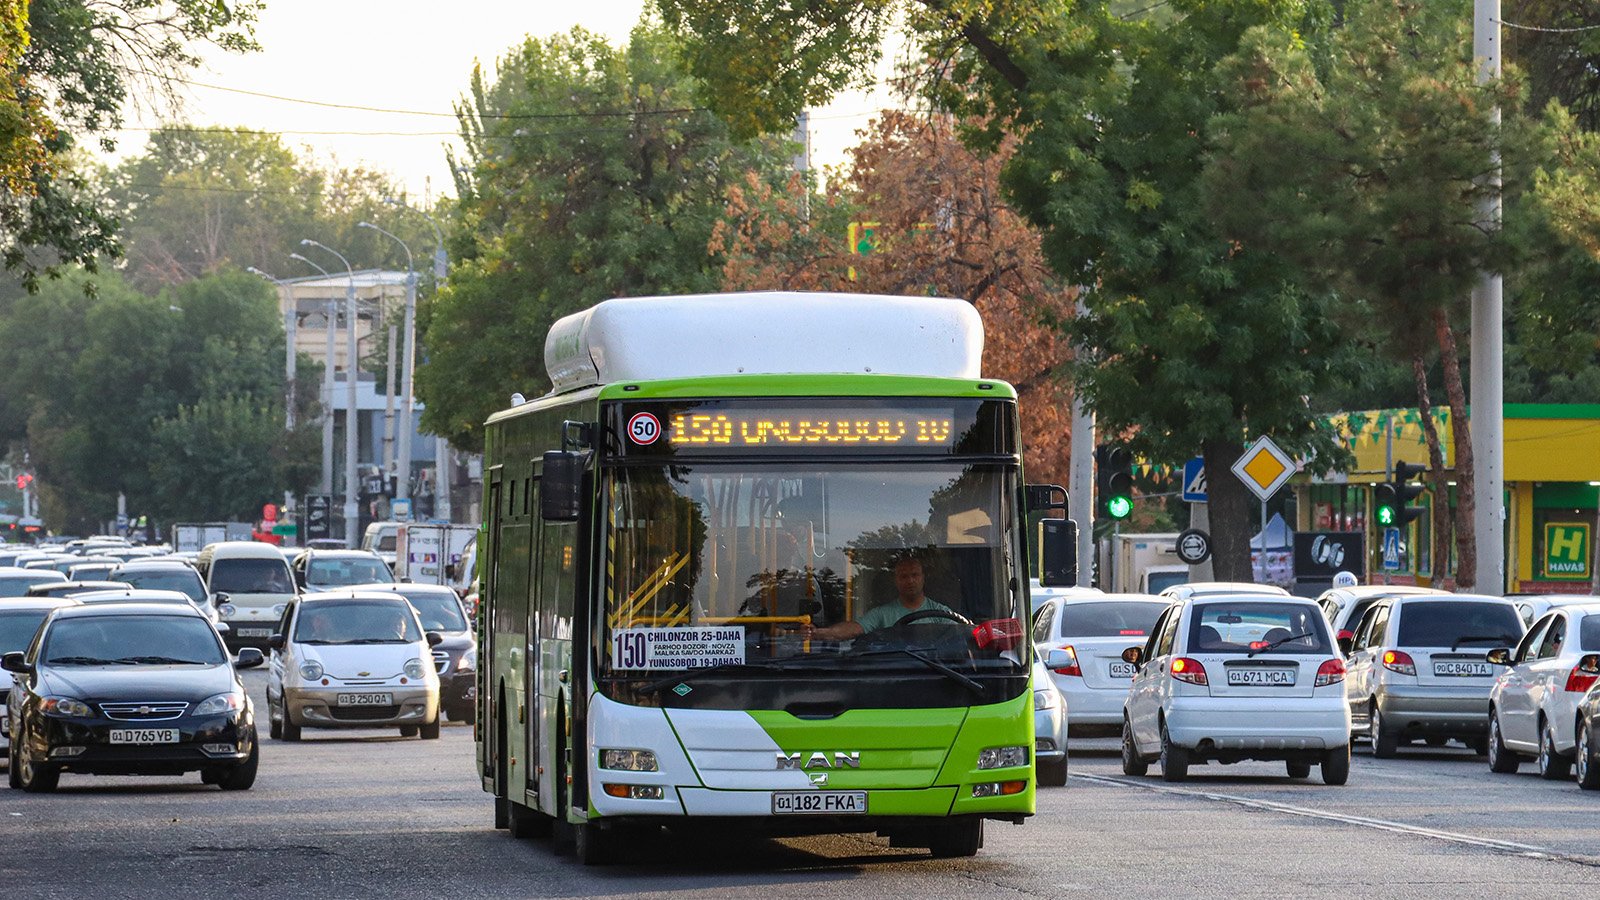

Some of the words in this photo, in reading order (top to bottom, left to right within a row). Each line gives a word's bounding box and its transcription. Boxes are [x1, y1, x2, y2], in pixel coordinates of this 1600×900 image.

[633, 422, 656, 435] 50
[672, 416, 732, 443] 150
[1550, 562, 1585, 572] HAVAS
[647, 631, 699, 642] CHILONZOR
[701, 631, 741, 641] 25-DAHA
[615, 632, 646, 668] 150
[648, 658, 697, 668] YUNUSOBOD
[700, 657, 742, 667] 19-DAHASI
[1112, 665, 1122, 673] 01
[1231, 673, 1241, 681] 01
[1243, 672, 1262, 682] 671
[1265, 672, 1288, 682] MCA
[112, 732, 123, 740] 01
[776, 752, 860, 769] MAN
[778, 797, 791, 809] 01
[794, 795, 822, 810] 182
[825, 795, 856, 810] FKA
